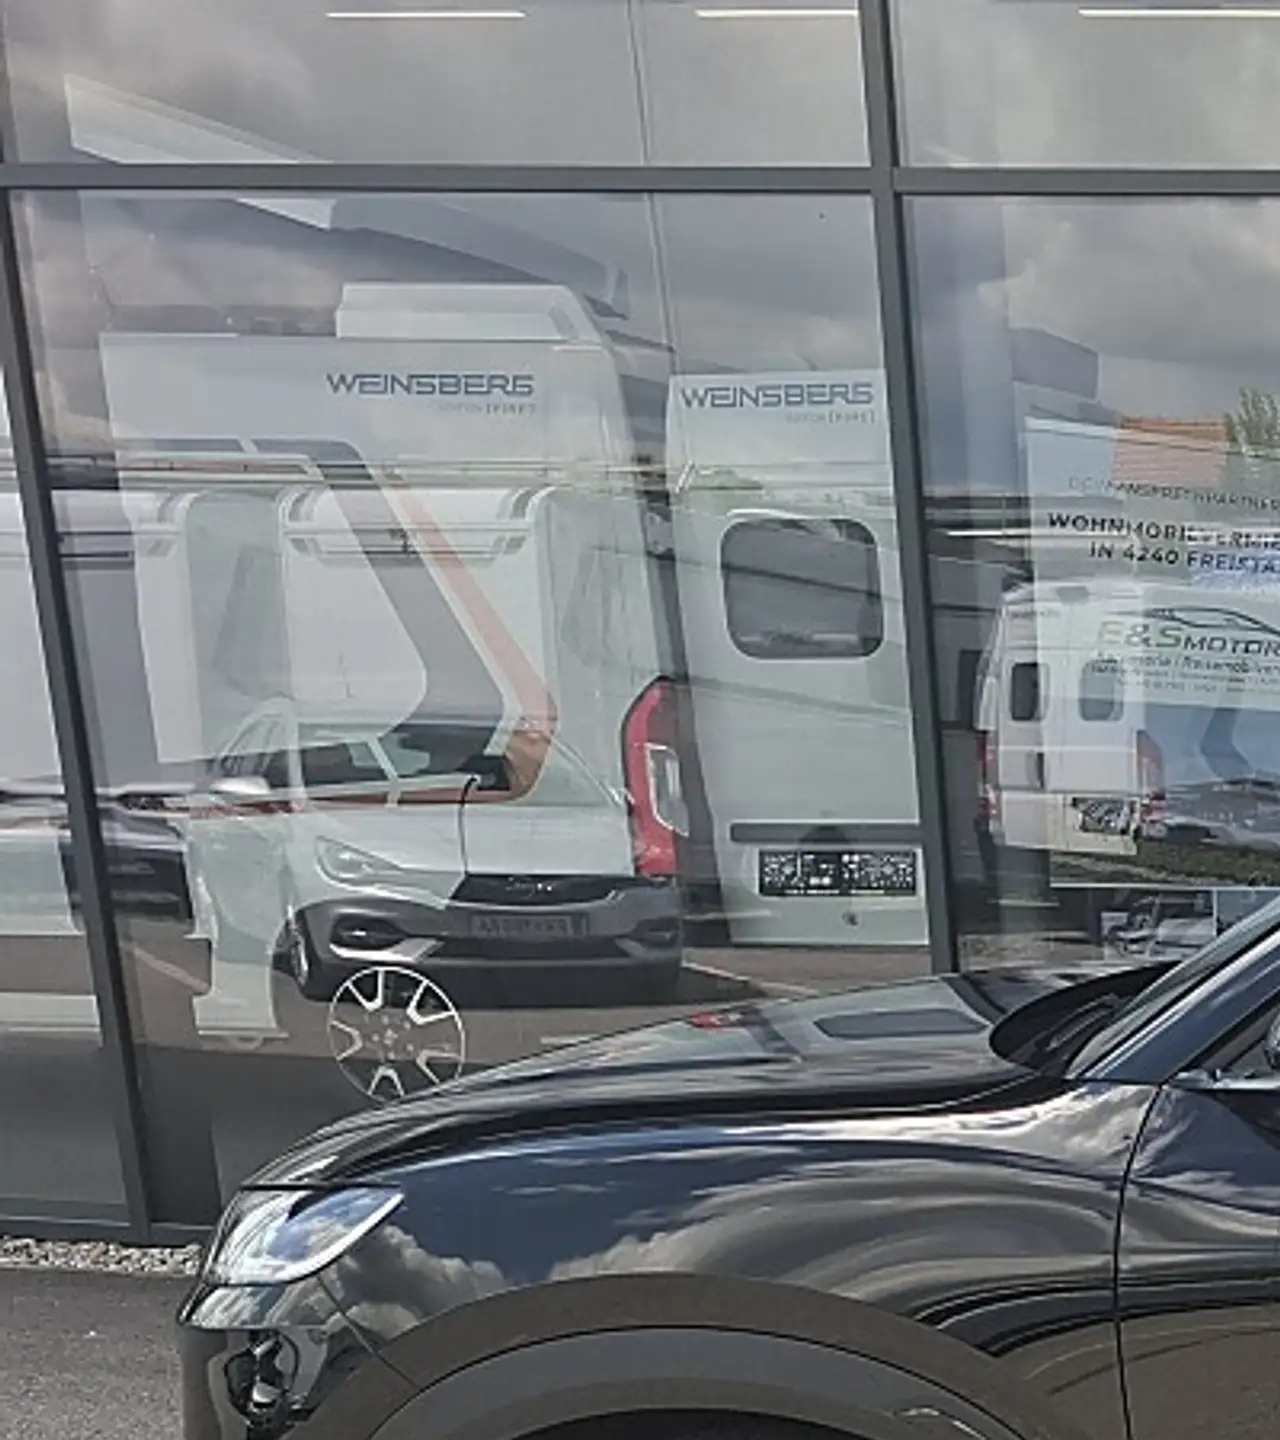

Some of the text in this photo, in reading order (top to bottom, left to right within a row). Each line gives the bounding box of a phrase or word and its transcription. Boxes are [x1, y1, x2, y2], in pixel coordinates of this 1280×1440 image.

[326, 373, 534, 395] WEINSBERG
[681, 382, 874, 408] WEINSBERG
[1089, 541, 1113, 559] IN
[1123, 544, 1179, 566] 4240
